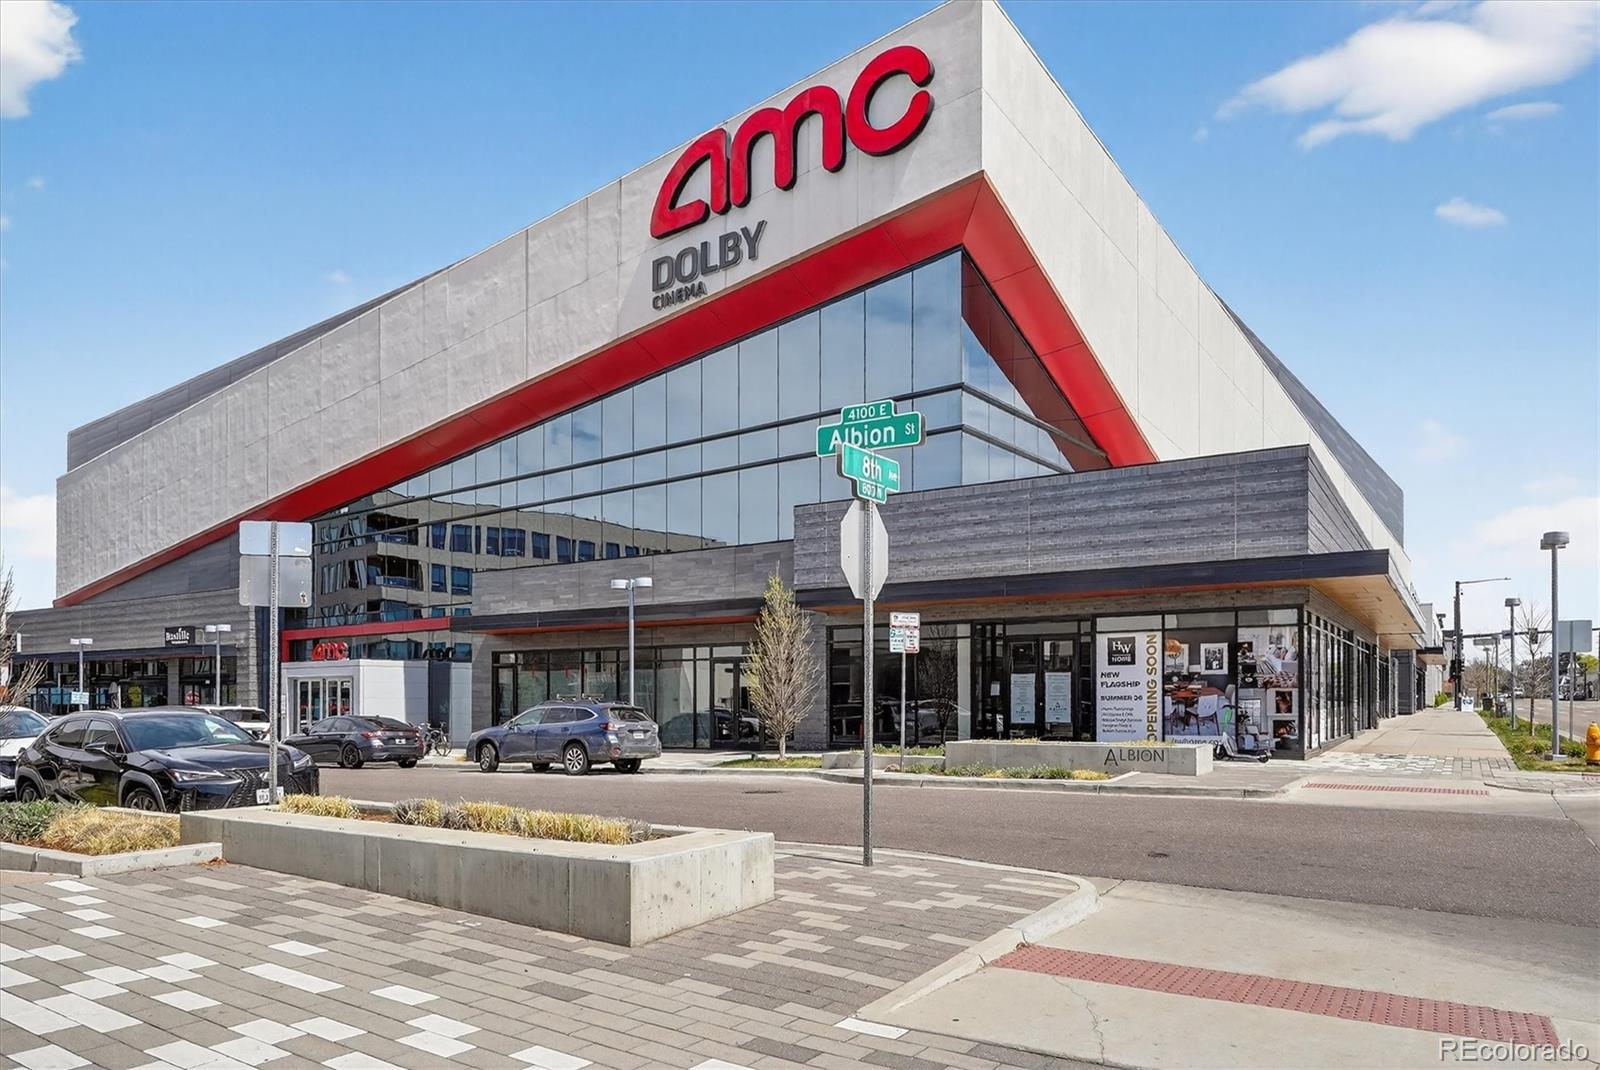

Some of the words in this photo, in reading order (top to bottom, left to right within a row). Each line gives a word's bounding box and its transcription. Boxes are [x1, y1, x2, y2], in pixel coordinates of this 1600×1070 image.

[652, 220, 767, 292] DOLBY
[652, 281, 707, 311] CINEMA
[848, 406, 876, 420] 4100
[880, 404, 886, 416] E
[829, 424, 895, 451] Albion
[905, 423, 915, 435] St
[862, 456, 882, 482] 8th
[1112, 641, 1132, 654] HW
[1146, 634, 1157, 675] SOON
[1146, 680, 1158, 742] OPENING
